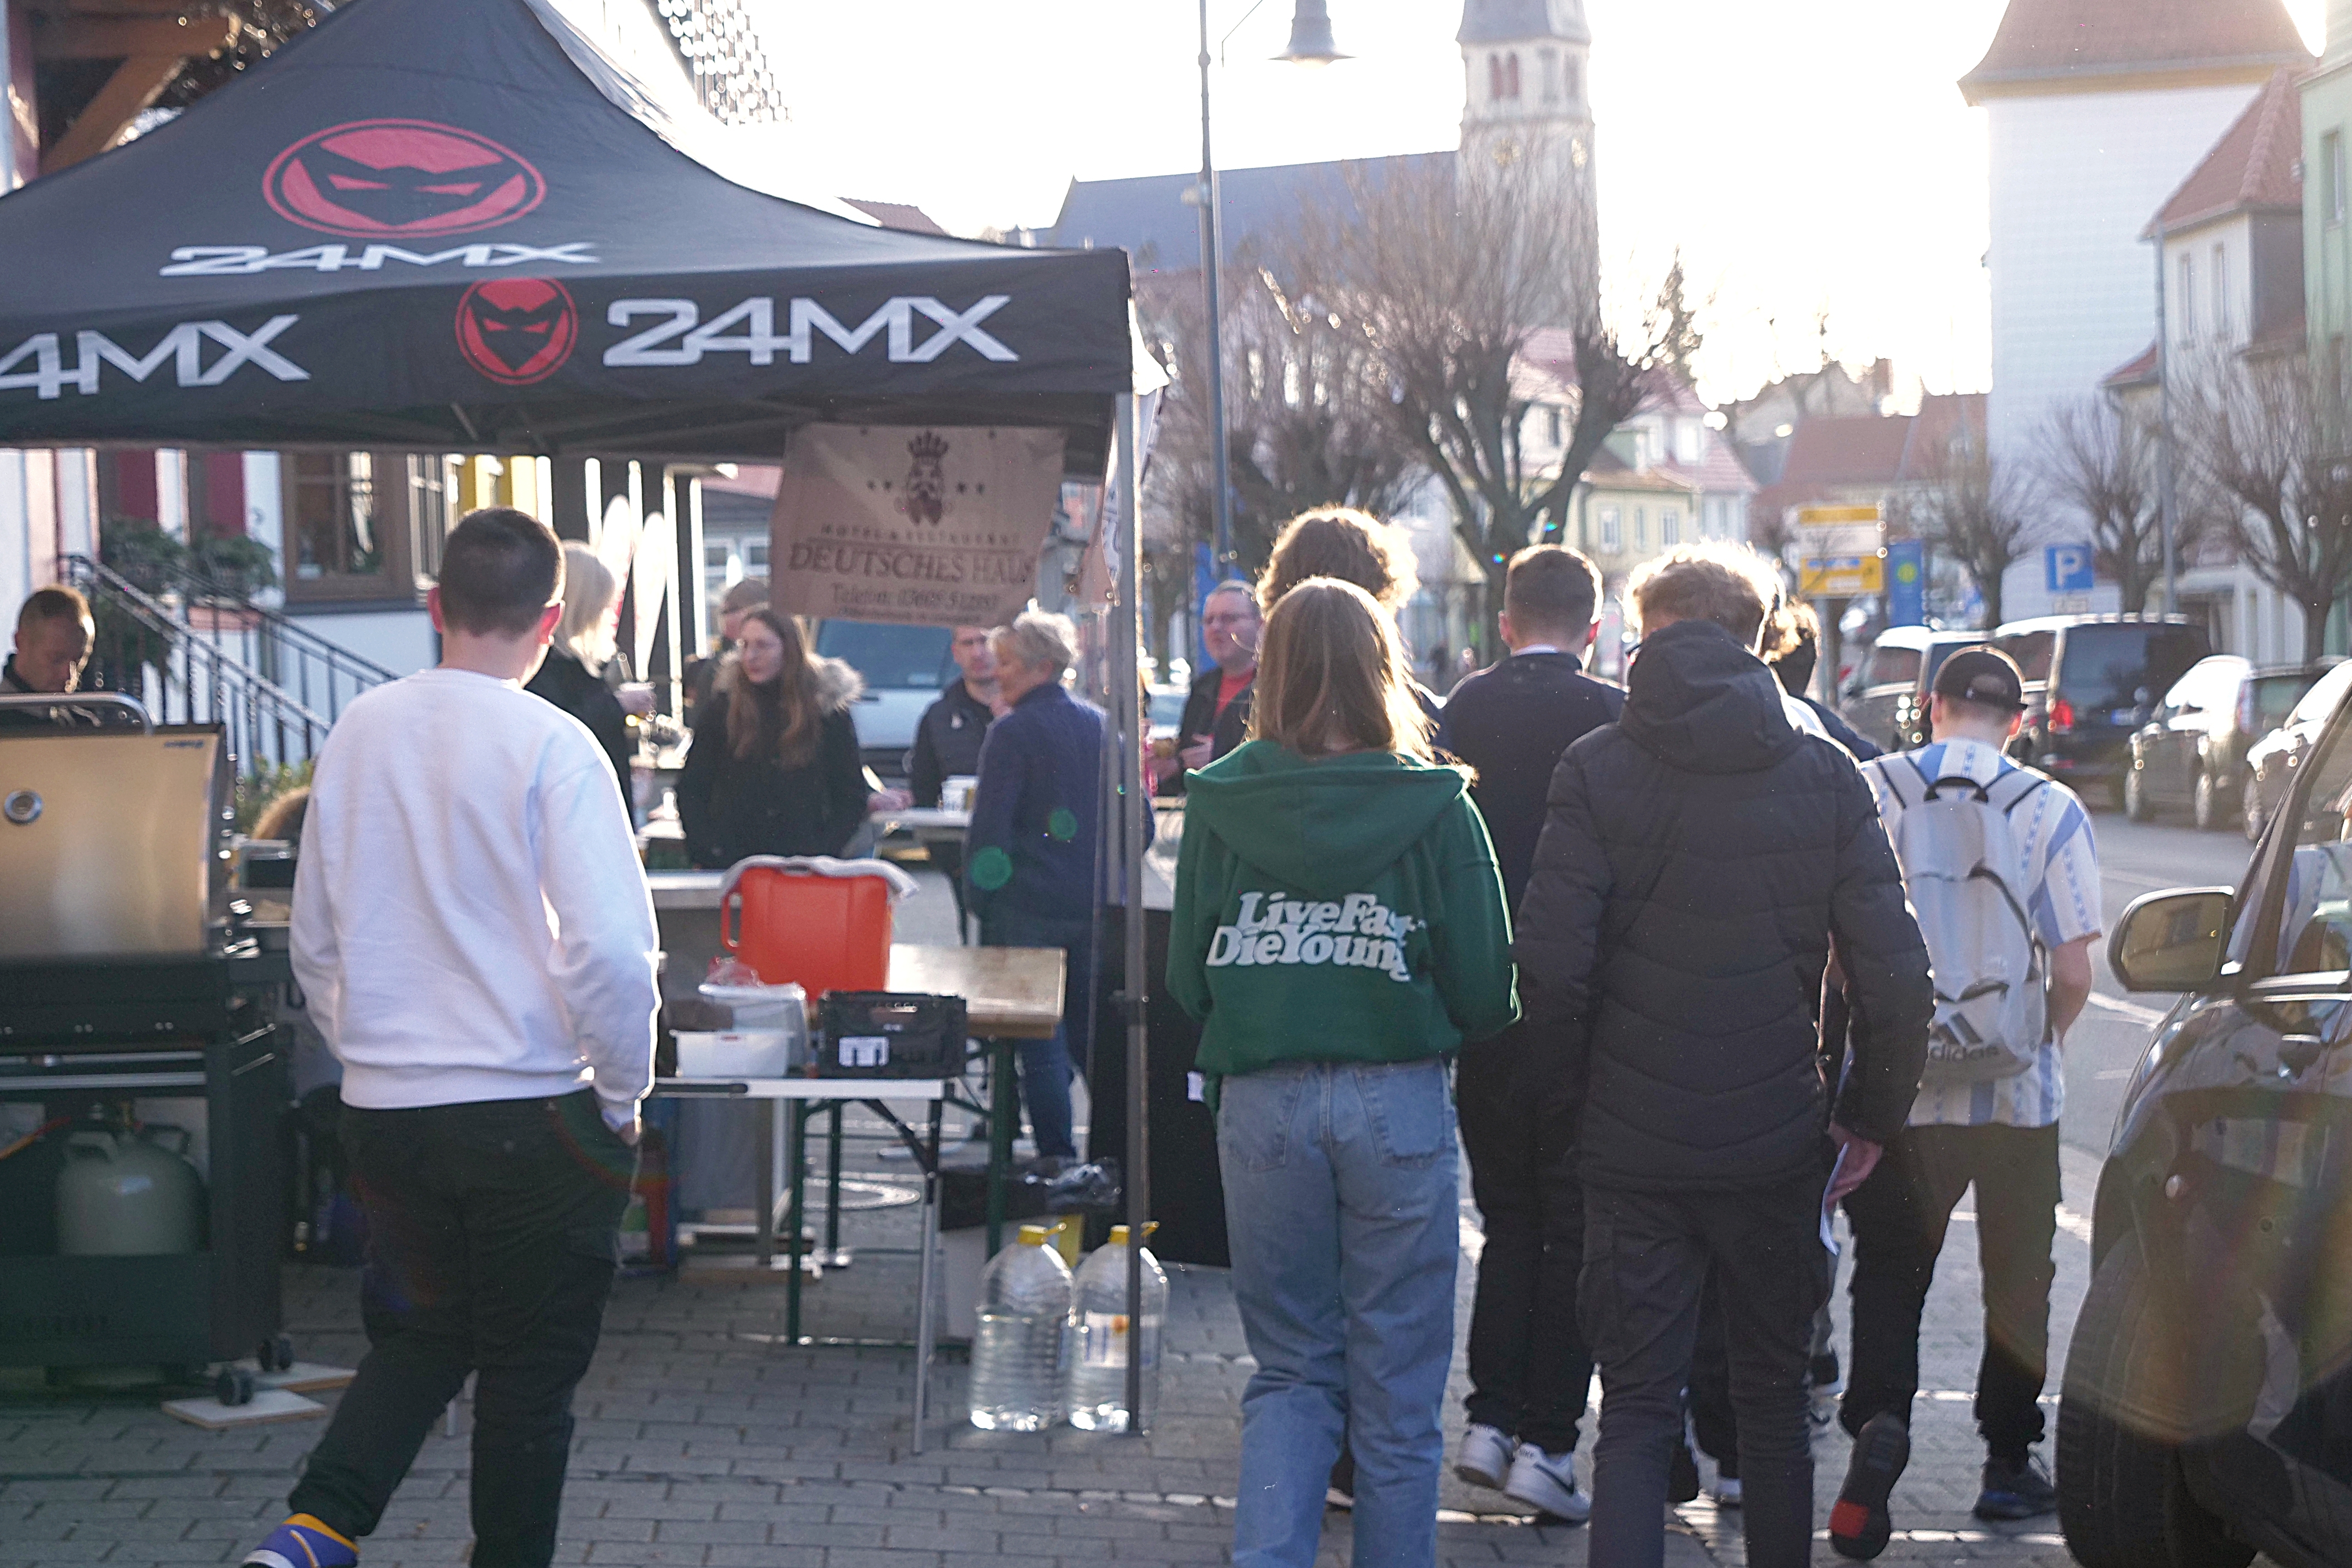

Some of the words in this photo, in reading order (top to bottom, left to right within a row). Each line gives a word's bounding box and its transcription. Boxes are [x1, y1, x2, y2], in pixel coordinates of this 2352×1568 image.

[160, 242, 601, 276] 24MX
[602, 294, 1020, 367] 24MX
[0, 314, 311, 400] 4MX
[789, 543, 964, 583] DEUTSCHES
[2056, 549, 2082, 587] P
[1928, 1043, 2000, 1061] didas
